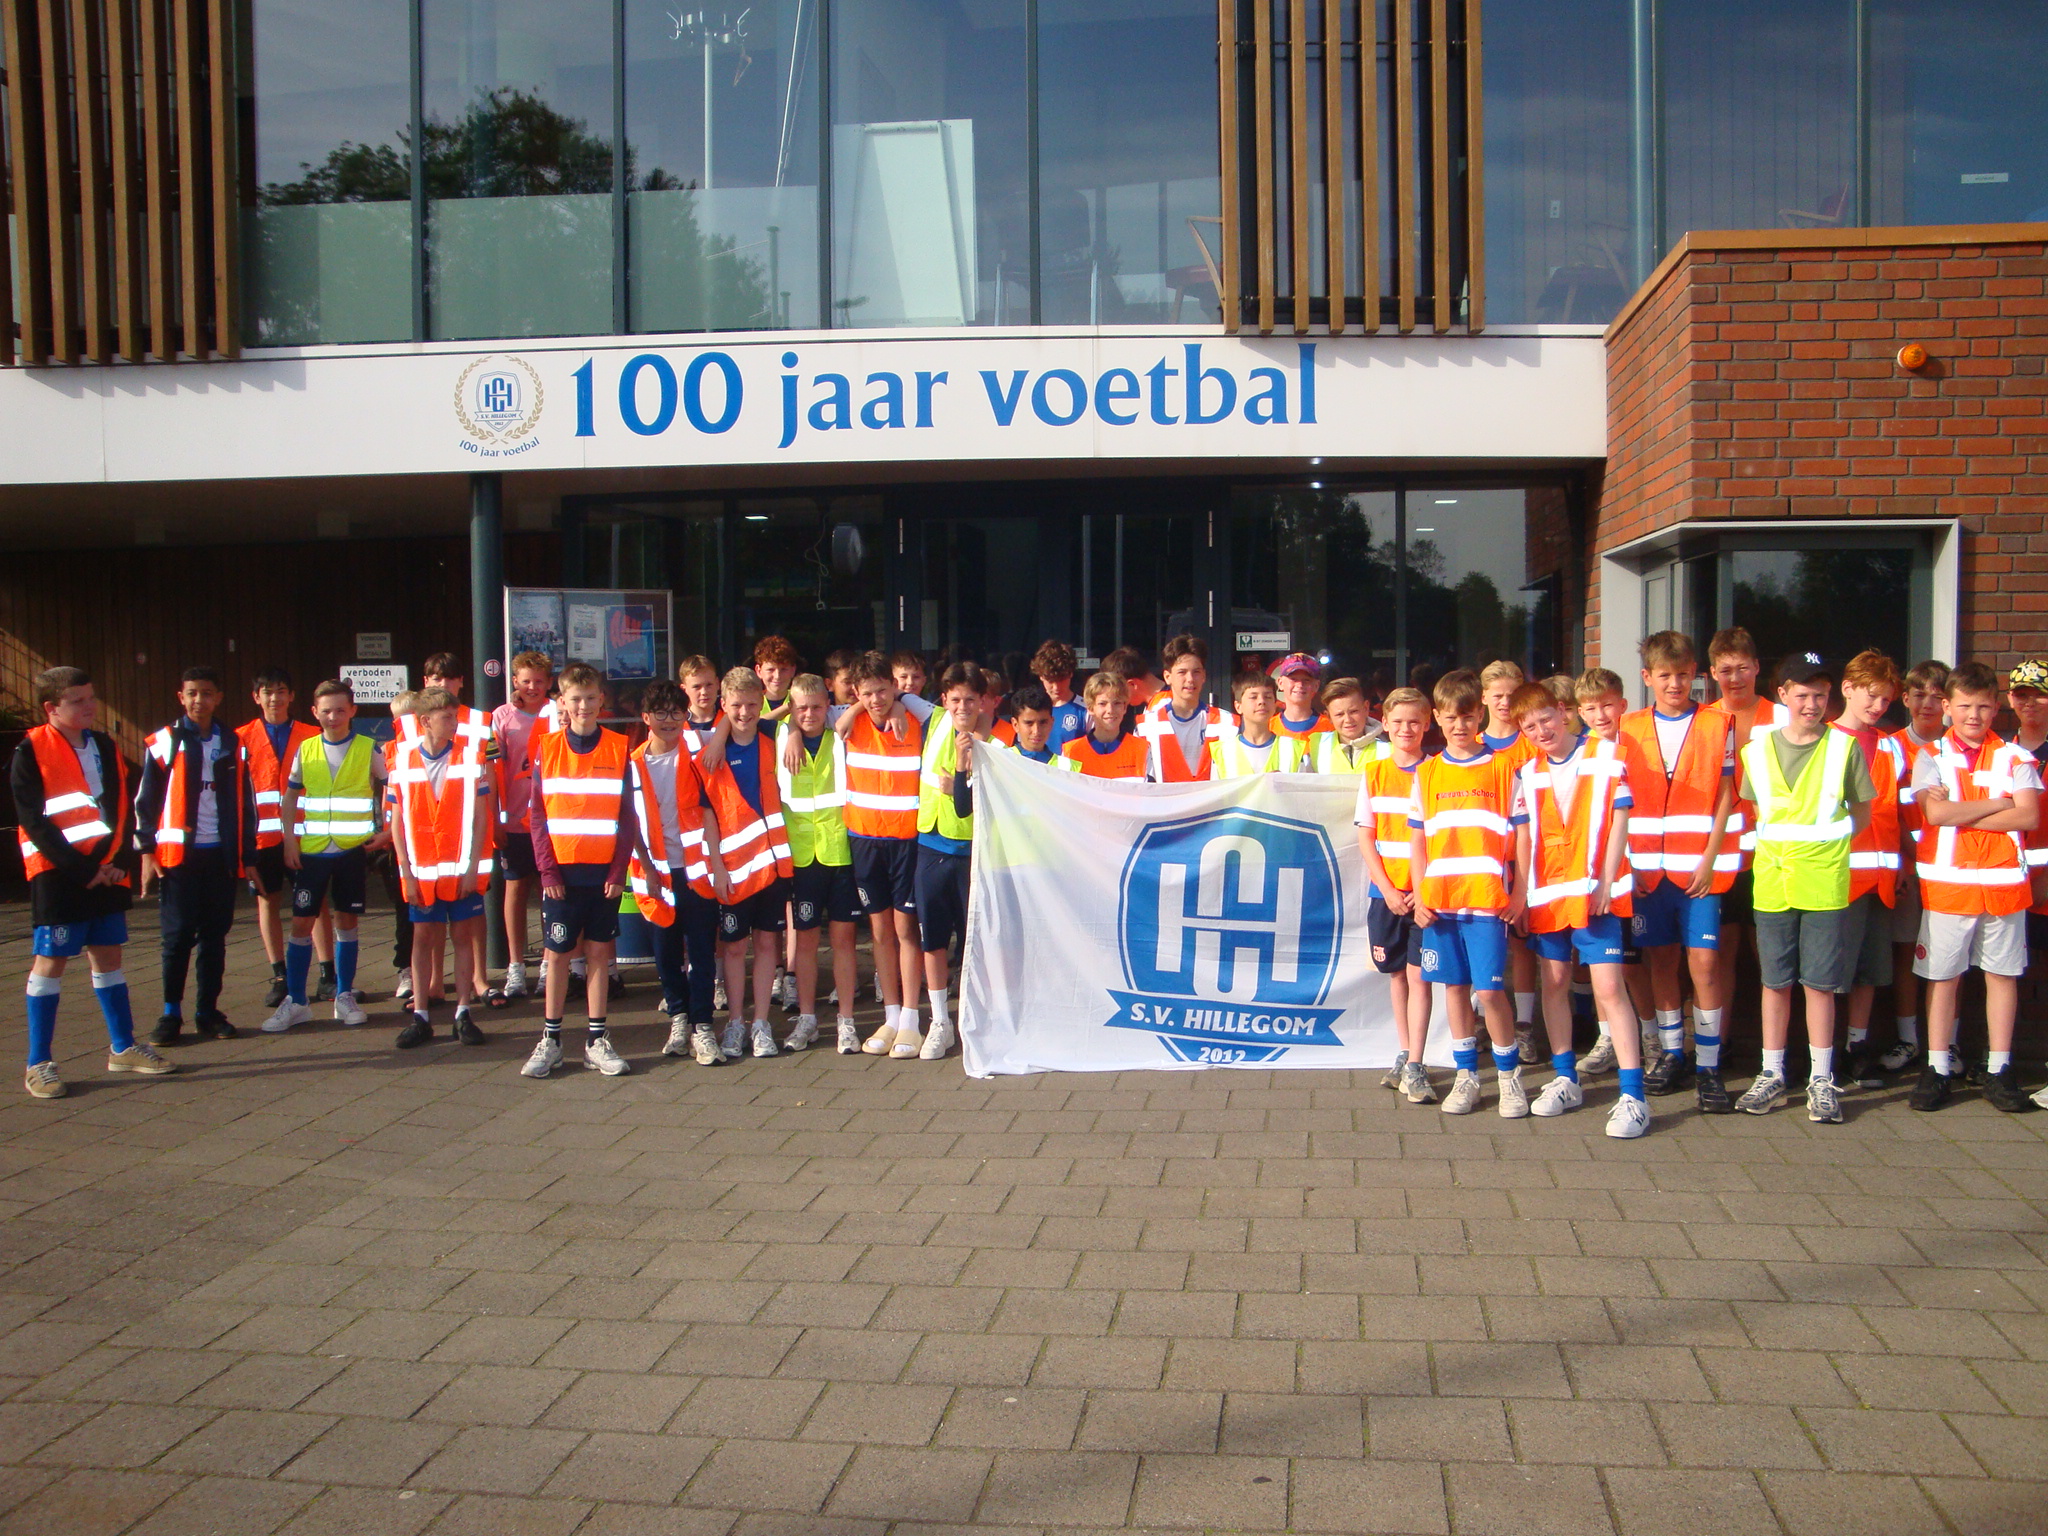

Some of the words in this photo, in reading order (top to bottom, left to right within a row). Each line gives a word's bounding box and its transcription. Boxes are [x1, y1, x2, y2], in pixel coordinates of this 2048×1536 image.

[570, 351, 744, 438] 100
[777, 351, 949, 449] jaar
[978, 343, 1318, 427] voetbal
[459, 439, 478, 453] 100
[480, 446, 500, 457] jaar
[502, 436, 540, 456] voetbal
[346, 668, 392, 677] verboden
[1130, 1002, 1175, 1027] S.V.
[1183, 1008, 1317, 1037] HILLEGOM
[1198, 1046, 1246, 1063] 2012
